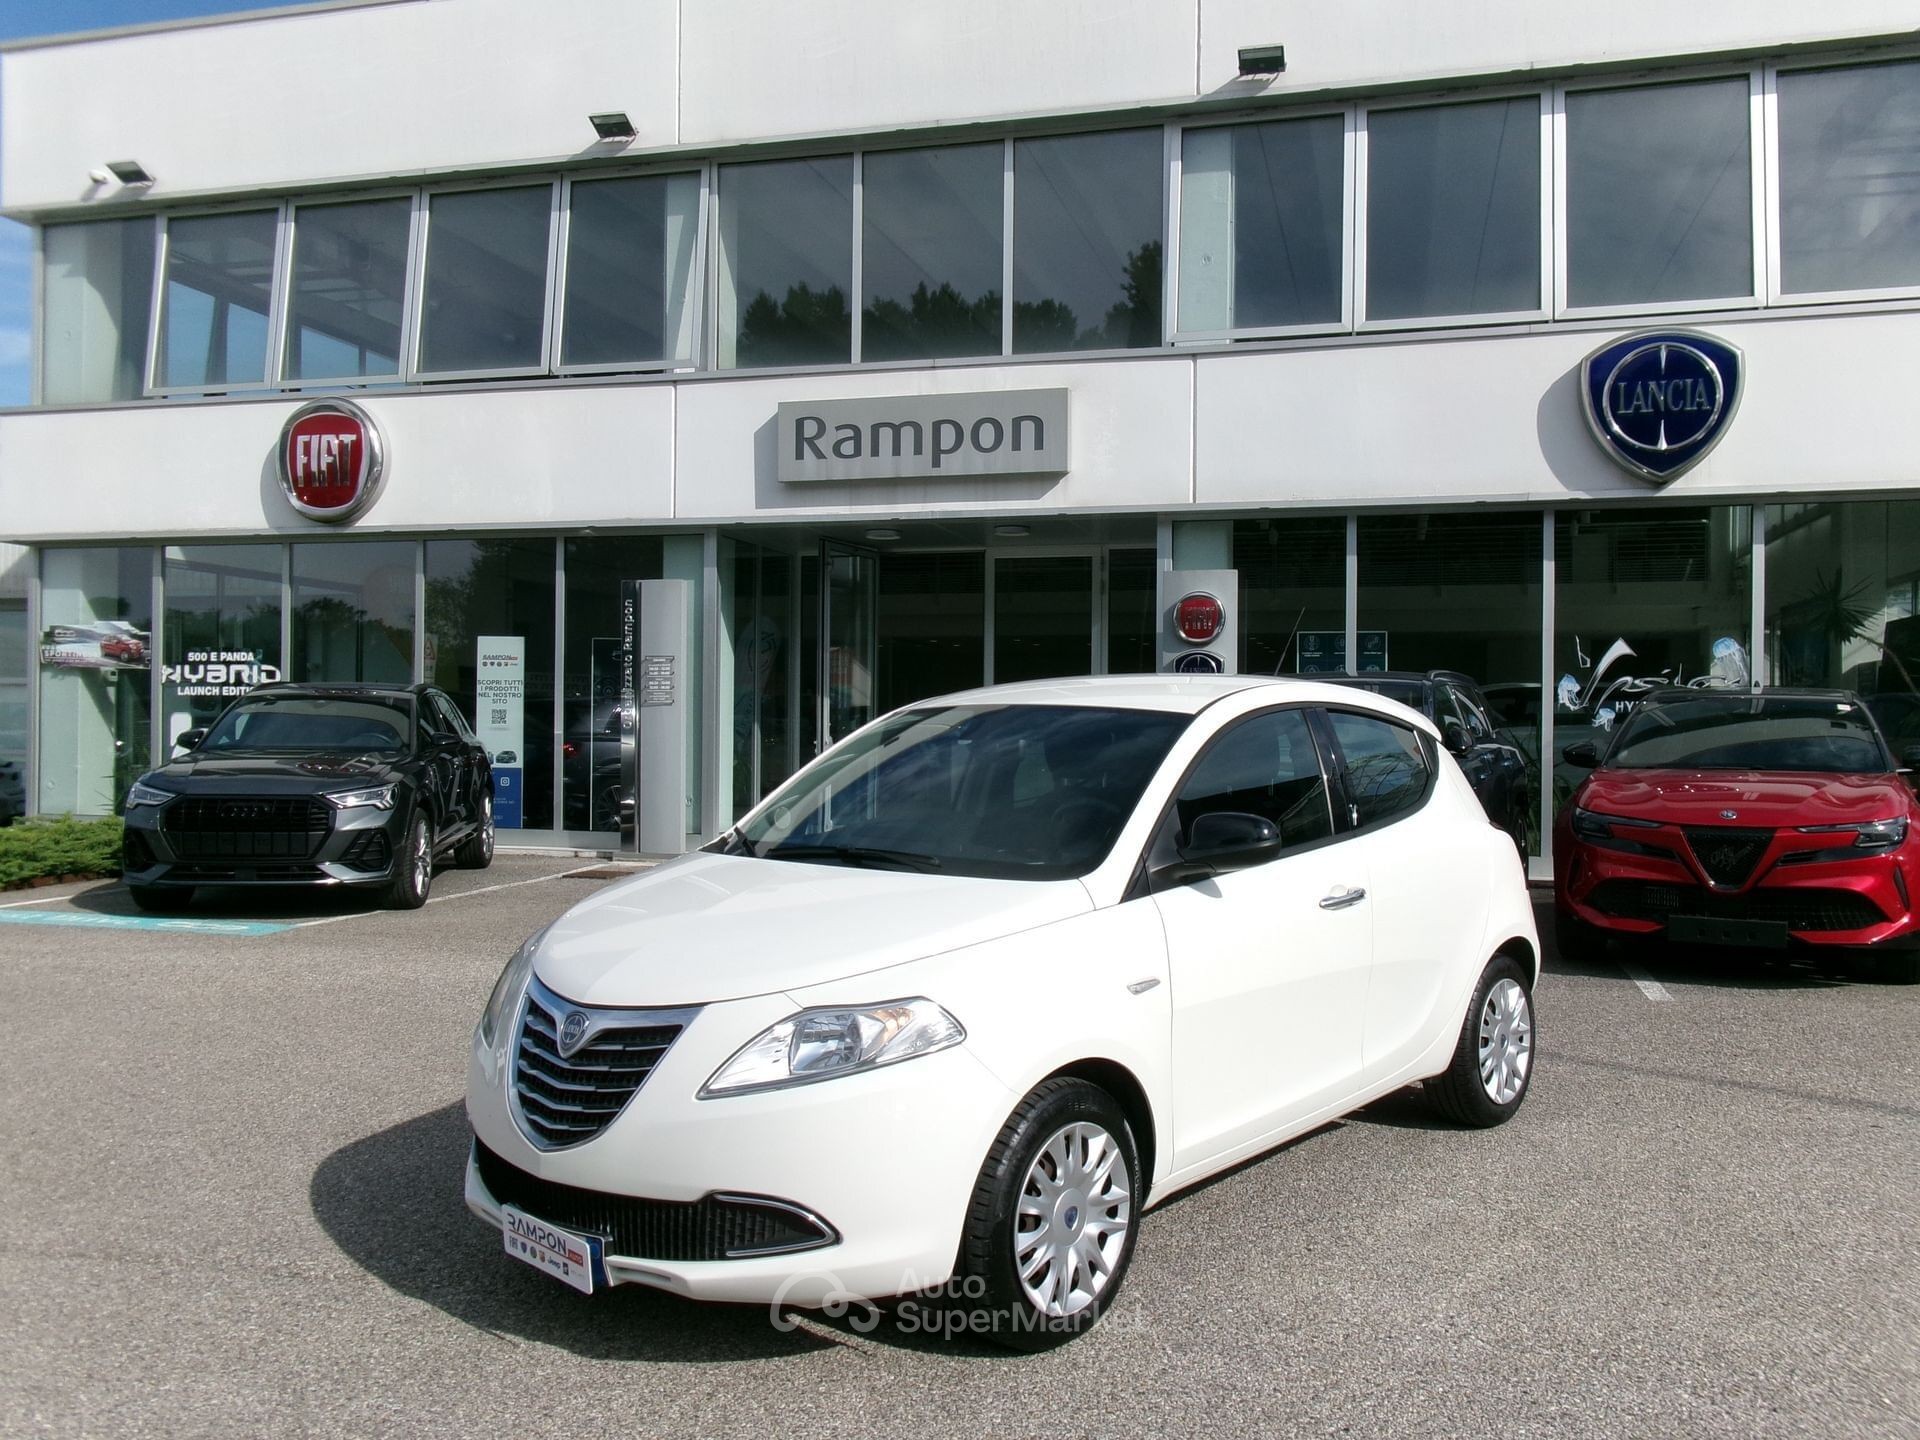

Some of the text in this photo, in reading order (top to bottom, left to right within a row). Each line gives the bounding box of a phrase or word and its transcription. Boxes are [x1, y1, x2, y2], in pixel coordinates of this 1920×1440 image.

[1617, 378, 1712, 414] LANCIA
[296, 433, 357, 488] FIAT
[795, 414, 1044, 468] Rampon
[622, 599, 635, 651] Rampon
[162, 664, 281, 683] HYBRID
[188, 652, 254, 661] 500 E PANDA
[178, 687, 219, 696] LAUNCH
[507, 1213, 567, 1255] RAMPON
